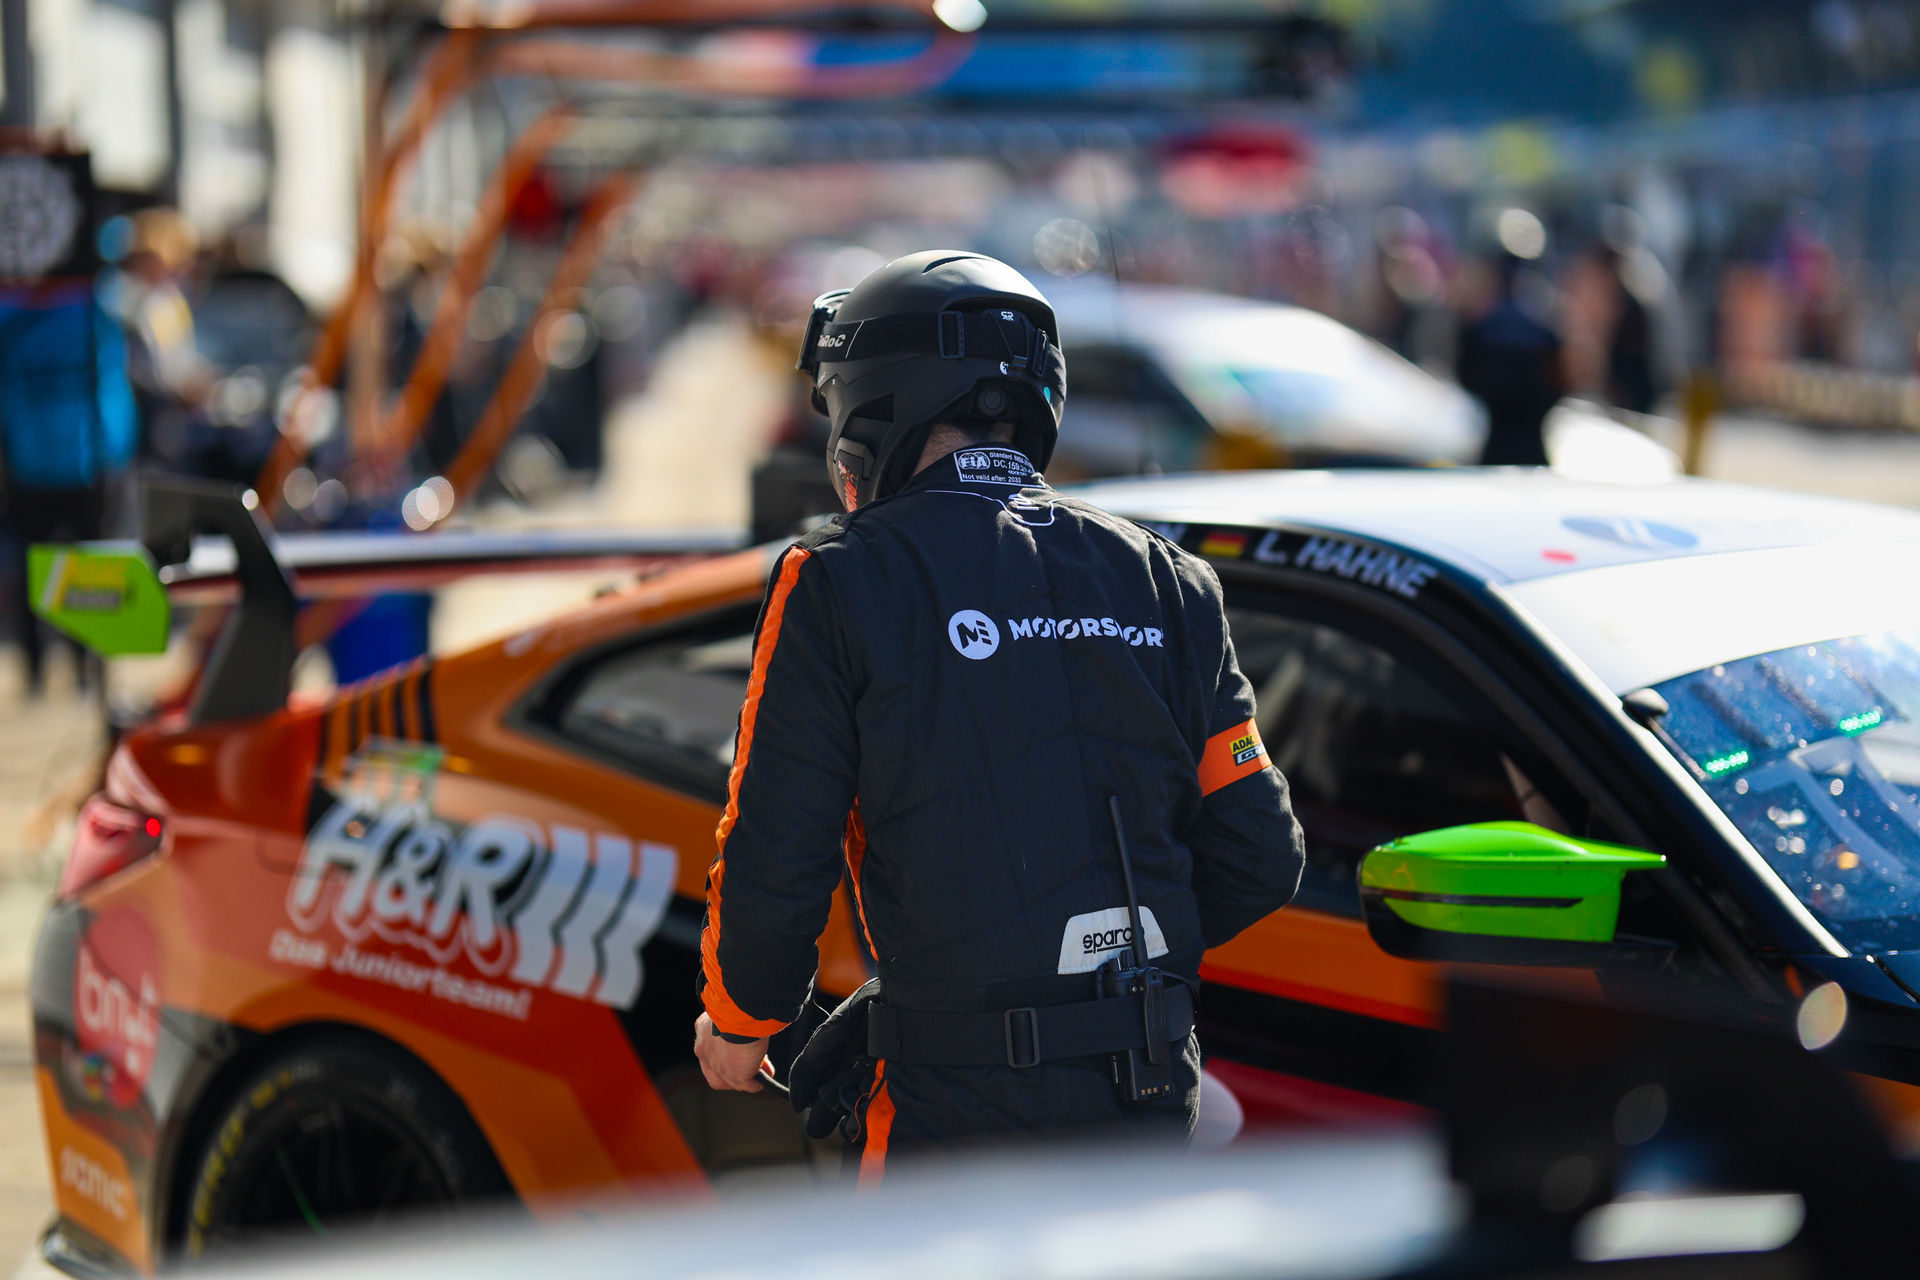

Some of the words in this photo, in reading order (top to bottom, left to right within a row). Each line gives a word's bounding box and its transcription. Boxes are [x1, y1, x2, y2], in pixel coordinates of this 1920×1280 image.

[961, 455, 988, 468] FIA
[1294, 533, 1438, 598] HAHNE
[1083, 927, 1133, 954] sparc
